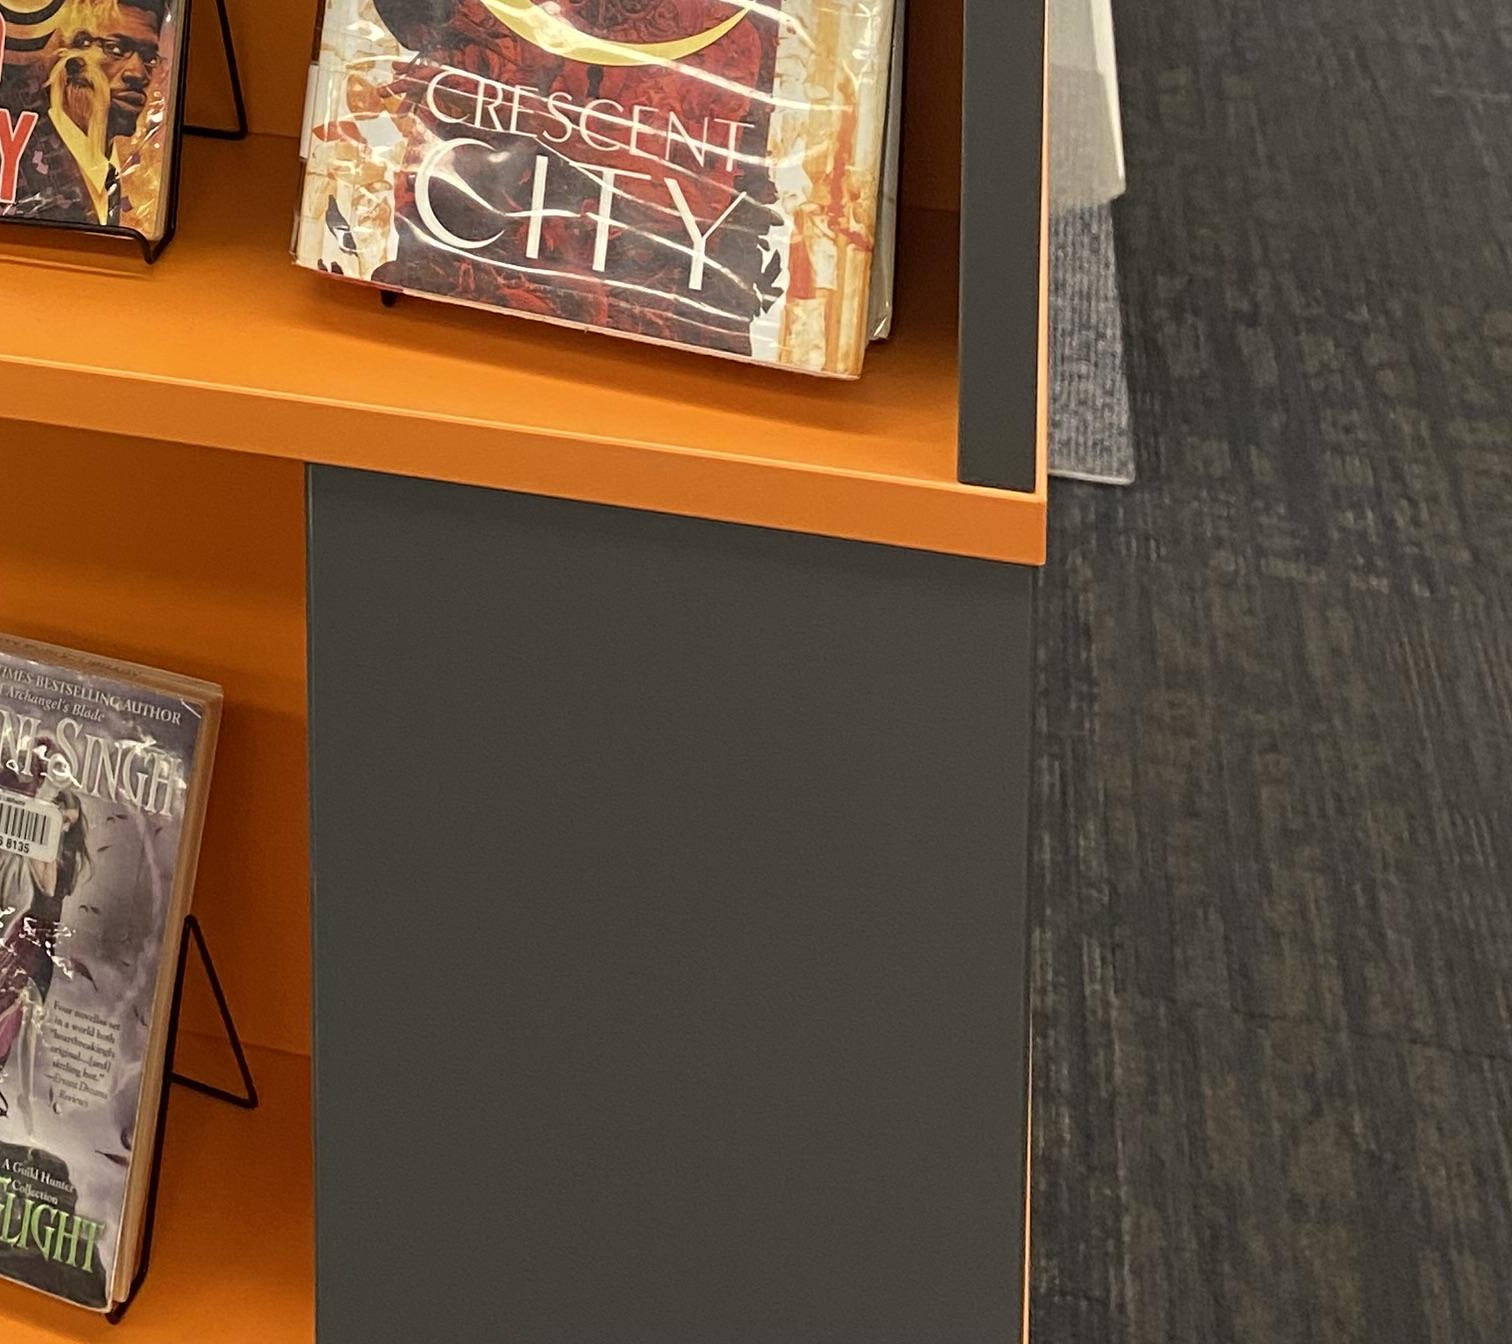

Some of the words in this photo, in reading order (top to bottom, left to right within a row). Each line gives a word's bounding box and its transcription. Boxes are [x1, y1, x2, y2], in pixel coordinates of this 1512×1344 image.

[426, 64, 755, 172] CRESCENT
[414, 137, 747, 292] CITY
[7, 686, 70, 713] Archangel's
[72, 704, 105, 723] Blade
[35, 675, 122, 711] BESTSELLING
[124, 698, 182, 726] AUTHOR
[54, 716, 184, 817] SINGH
[6, 838, 30, 853] 8135
[2, 1159, 9, 1170] A
[13, 1162, 38, 1181] Guild
[41, 1172, 75, 1193] Hunter
[12, 1180, 58, 1205] Collection
